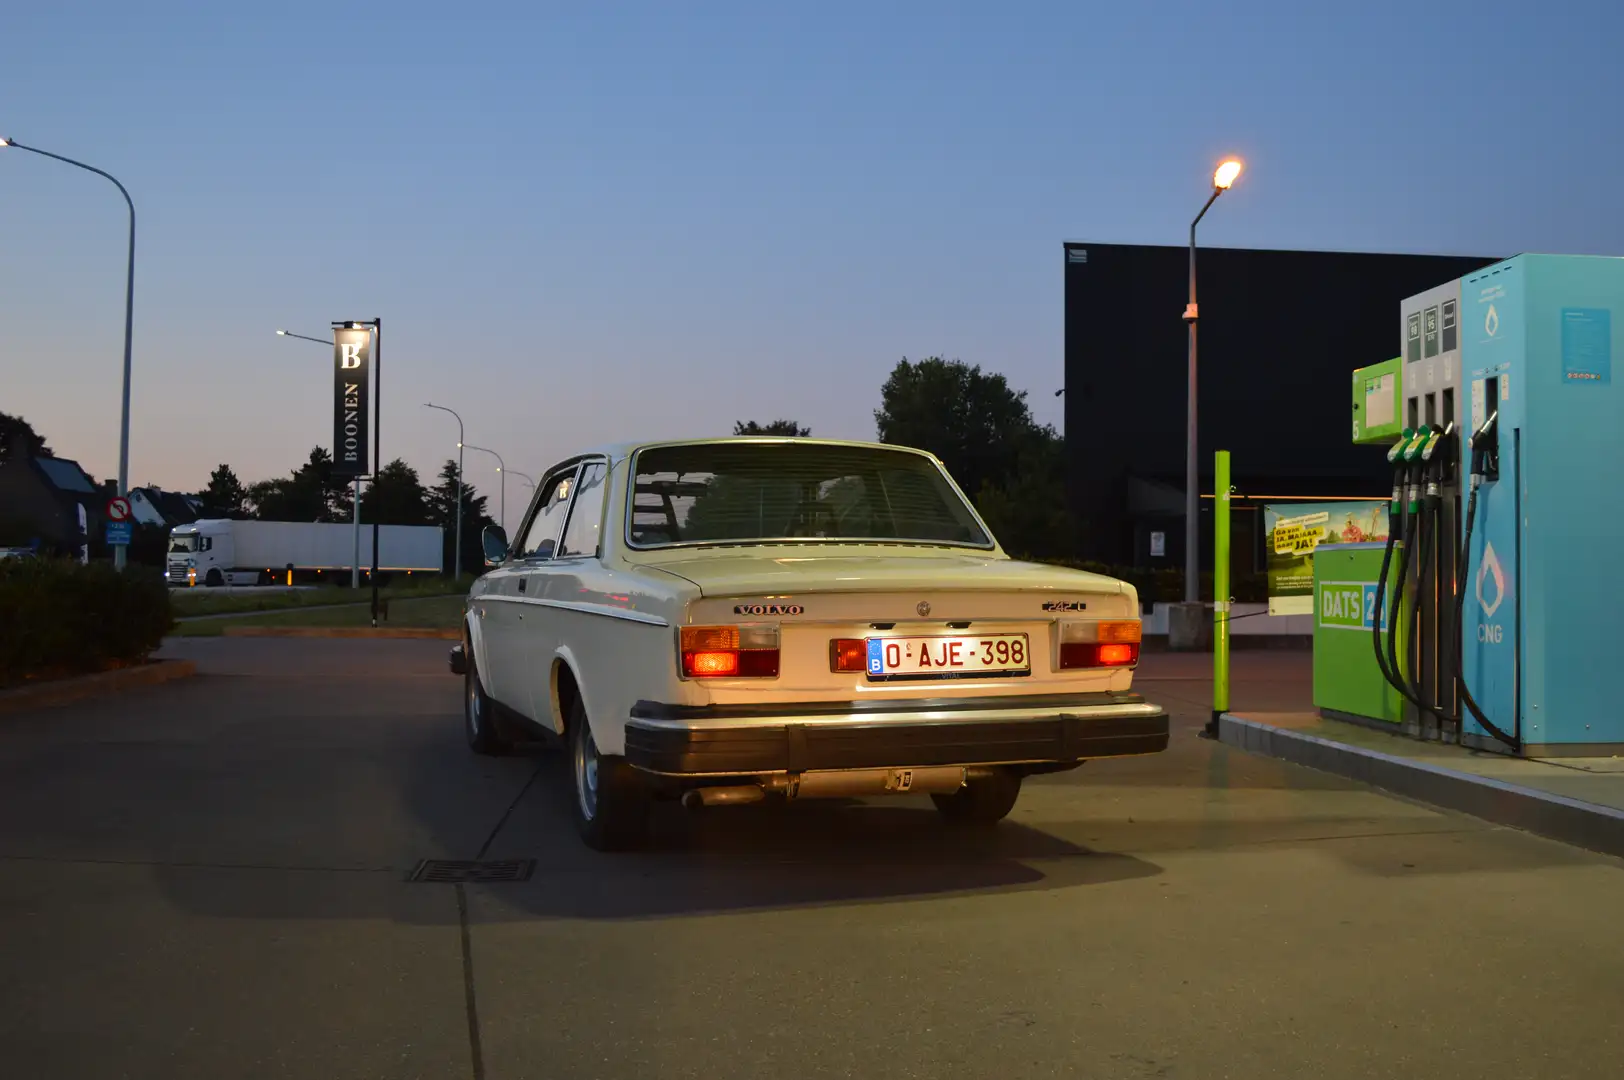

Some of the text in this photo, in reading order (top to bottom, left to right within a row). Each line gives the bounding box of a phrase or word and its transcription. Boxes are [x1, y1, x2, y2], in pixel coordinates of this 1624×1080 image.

[340, 342, 361, 369] B
[344, 382, 358, 462] BOONEN
[1294, 538, 1314, 550] JA!
[739, 604, 801, 616] VOLVO
[1046, 600, 1073, 612] 242
[1323, 590, 1384, 621] DATS 2
[1477, 623, 1503, 644] CNG
[871, 658, 881, 671] B
